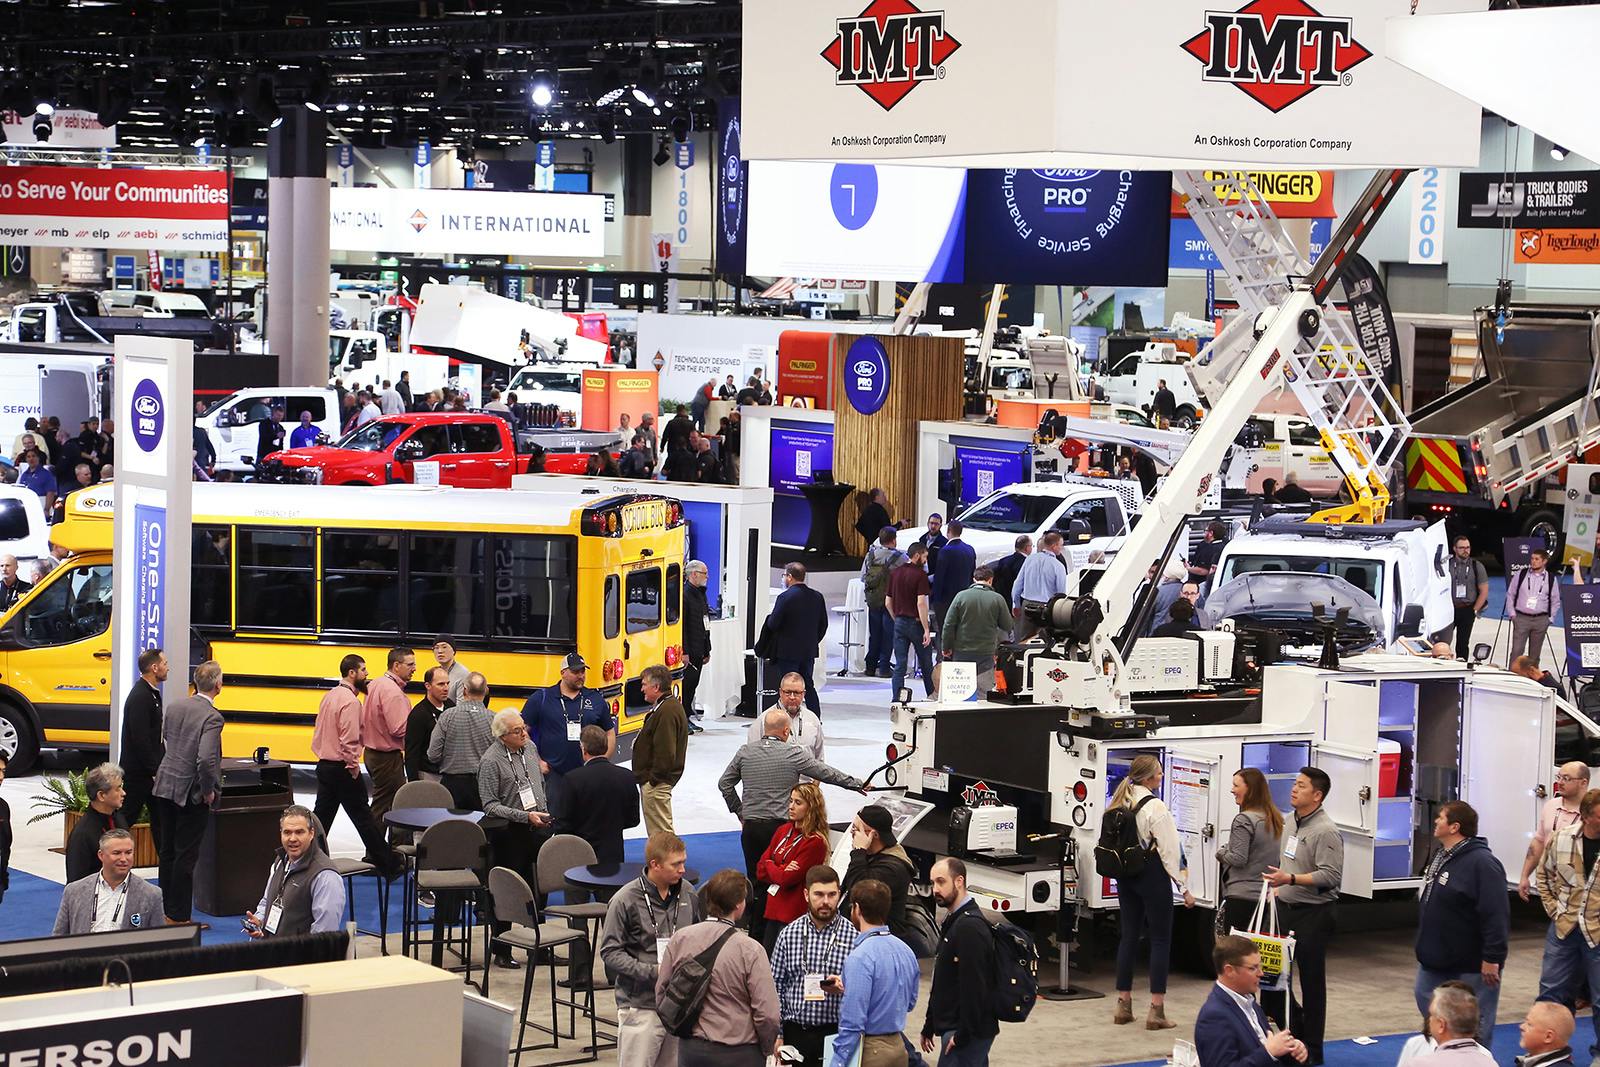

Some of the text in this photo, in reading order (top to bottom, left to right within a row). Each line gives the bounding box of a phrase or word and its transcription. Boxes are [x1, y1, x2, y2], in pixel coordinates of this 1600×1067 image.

[836, 10, 945, 85] IMT
[1202, 10, 1353, 86] IMT
[81, 115, 108, 129] schm
[831, 133, 947, 148] An Oshkosh Corporation Company
[1194, 135, 1352, 151] An Oshkosh Corporation Company
[17, 178, 66, 200] Serve
[70, 181, 110, 201] Your
[115, 181, 228, 204] Communities
[1527, 180, 1588, 194] TRUCK BODIES
[1044, 188, 1087, 205] PRO
[1096, 170, 1133, 239] Charging
[1534, 194, 1574, 207] TRAILERS
[678, 173, 688, 244] 1800
[1418, 168, 1439, 259] 2200
[1539, 209, 1547, 218] for
[1548, 209, 1557, 217] the
[1558, 208, 1571, 218] Long
[441, 214, 591, 234] INTERNATIONAL
[51, 227, 69, 237] mb
[92, 228, 110, 241] elp
[134, 229, 158, 239] aebi
[182, 231, 228, 242] schmidt
[1546, 233, 1600, 251] TigerTough
[1038, 236, 1091, 254] Service
[1354, 301, 1374, 327] THE
[1371, 304, 1387, 337] HAUL
[1360, 326, 1378, 349] FOR
[674, 356, 741, 366] TECHNOLOGY DESIGNED
[674, 365, 720, 374] FOR THE FUTURE
[625, 503, 664, 532] SCHOOL BUS
[1571, 615, 1598, 623] Schedule
[1164, 666, 1182, 674] EPEQ
[995, 822, 1014, 831] EPEQ
[0, 1028, 192, 1067] ERSON
